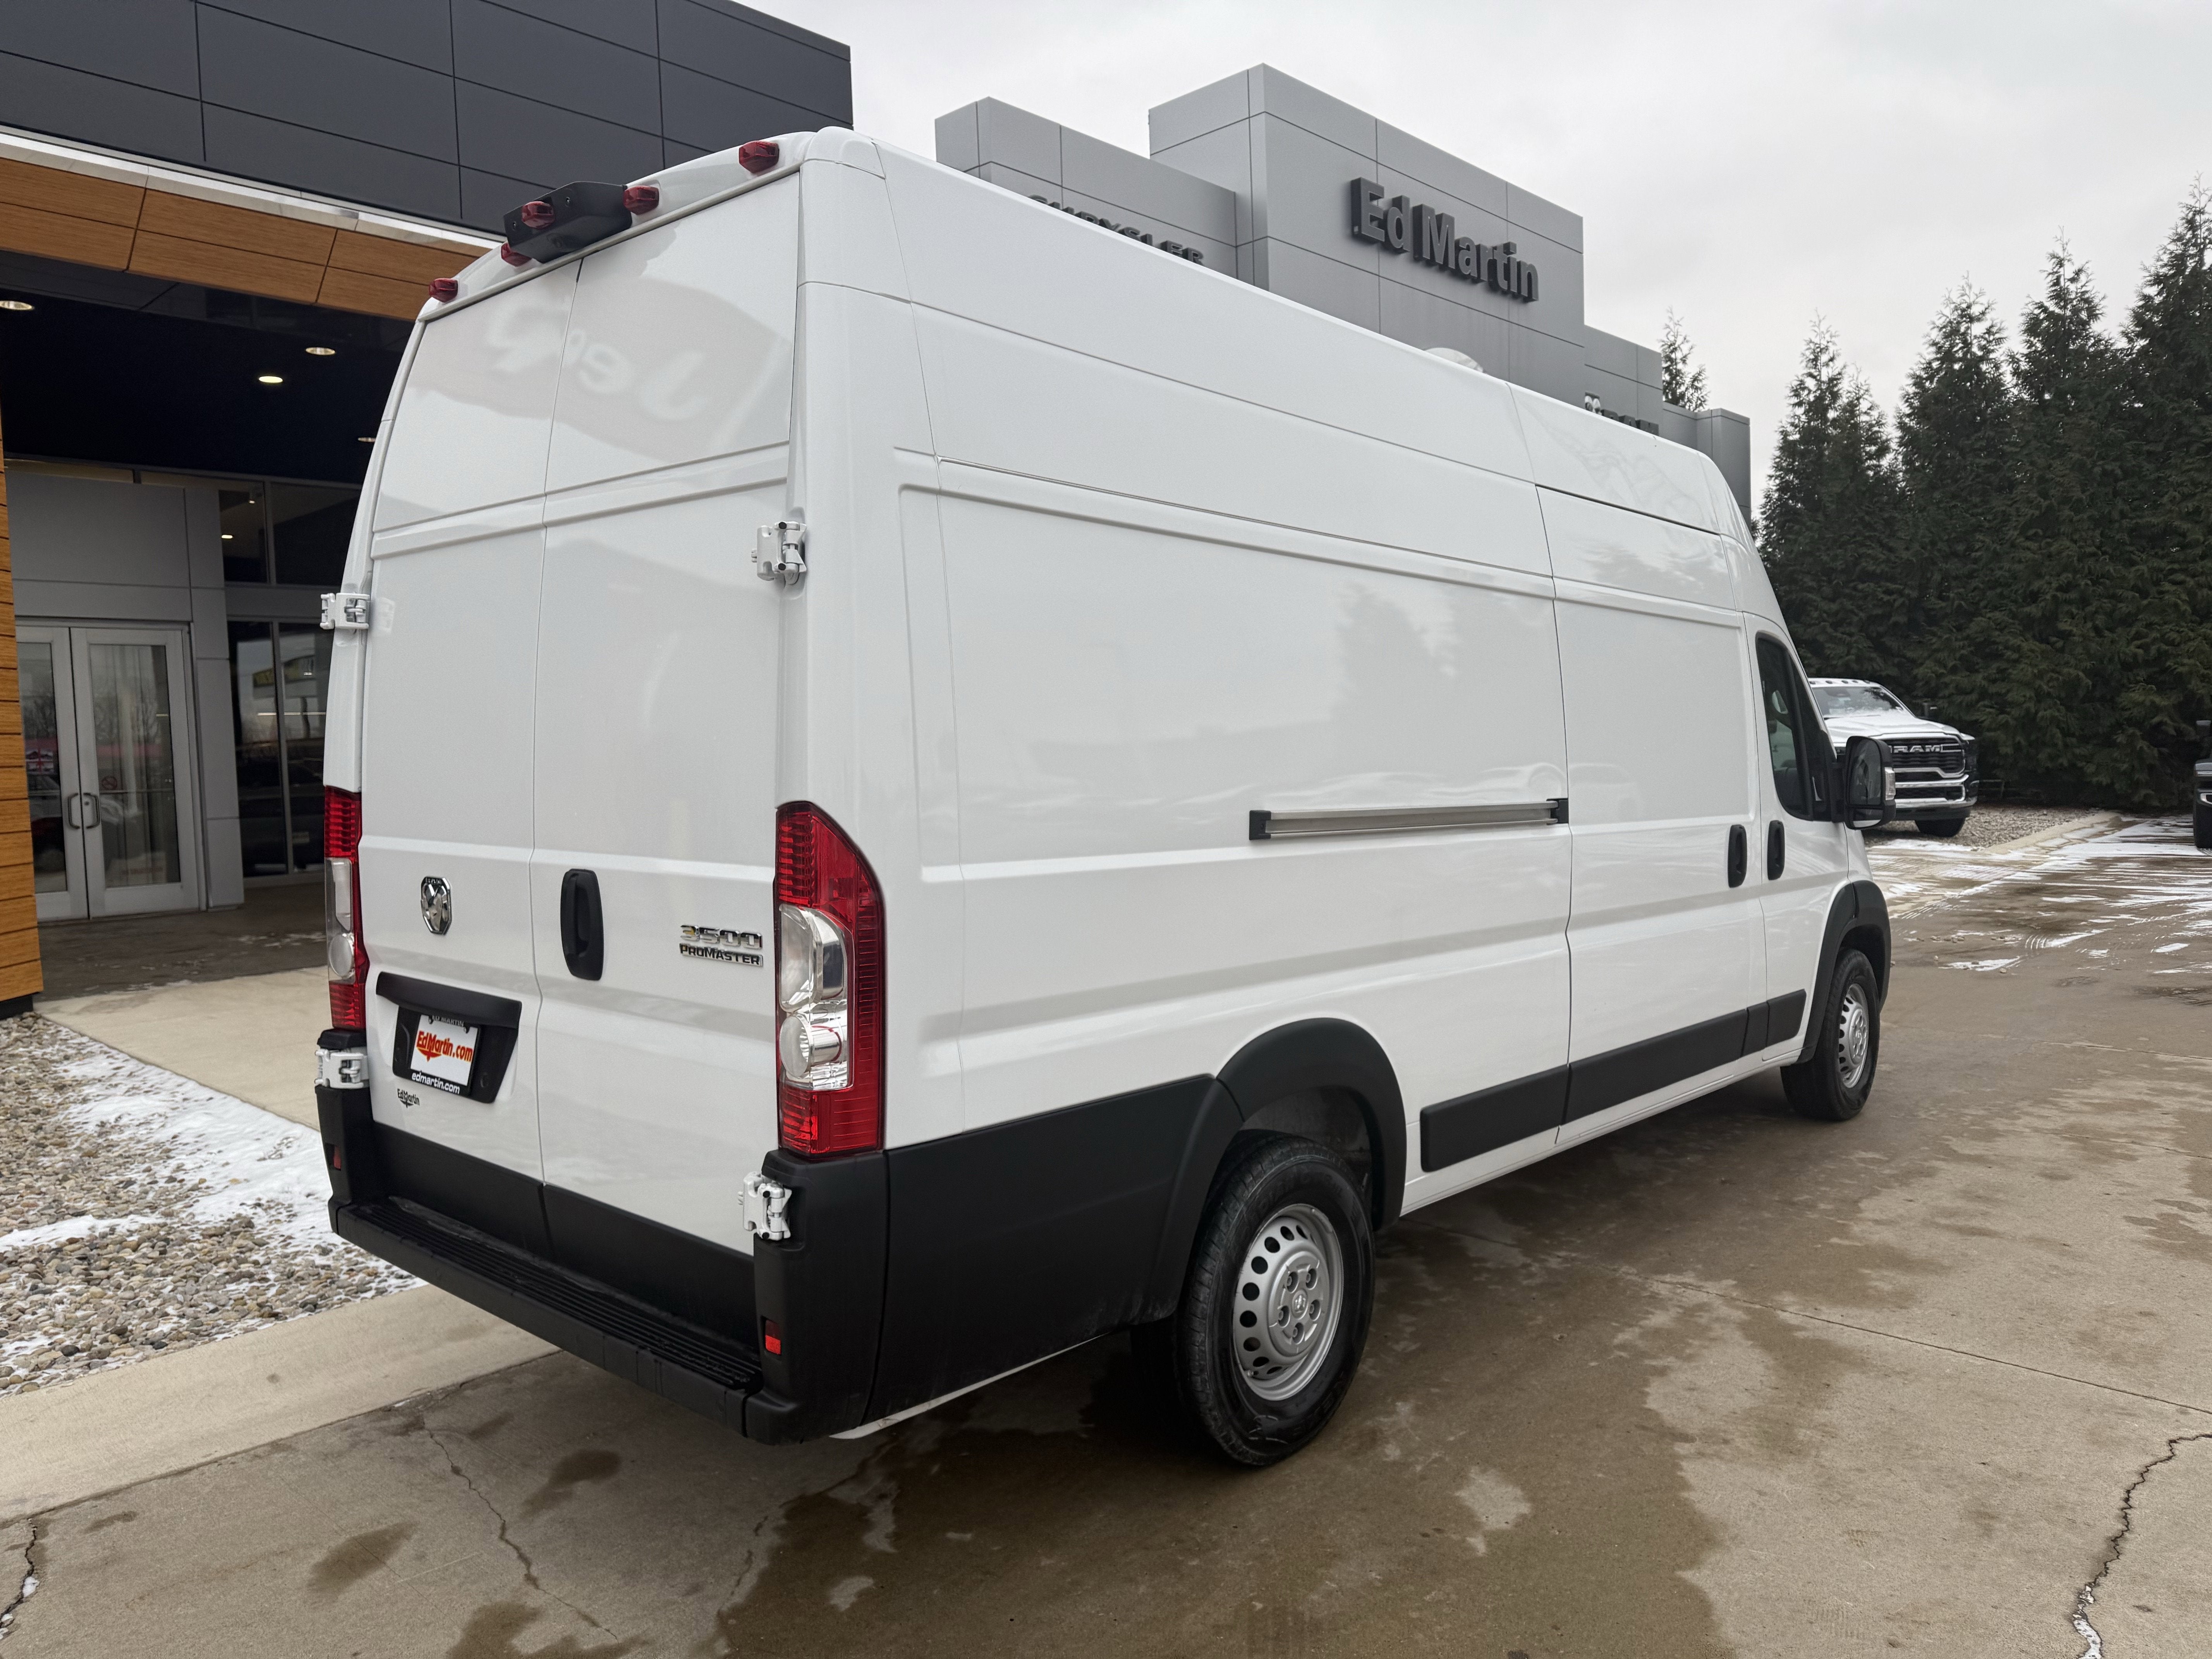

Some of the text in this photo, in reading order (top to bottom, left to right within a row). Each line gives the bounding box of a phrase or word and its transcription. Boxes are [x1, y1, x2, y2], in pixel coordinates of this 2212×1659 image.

[1351, 177, 1539, 302] Ed Martin
[1893, 745, 1940, 753] RAM
[680, 925, 763, 950] 3500
[441, 1017, 464, 1027] MARTIN
[412, 1072, 460, 1094] edmartin.com
